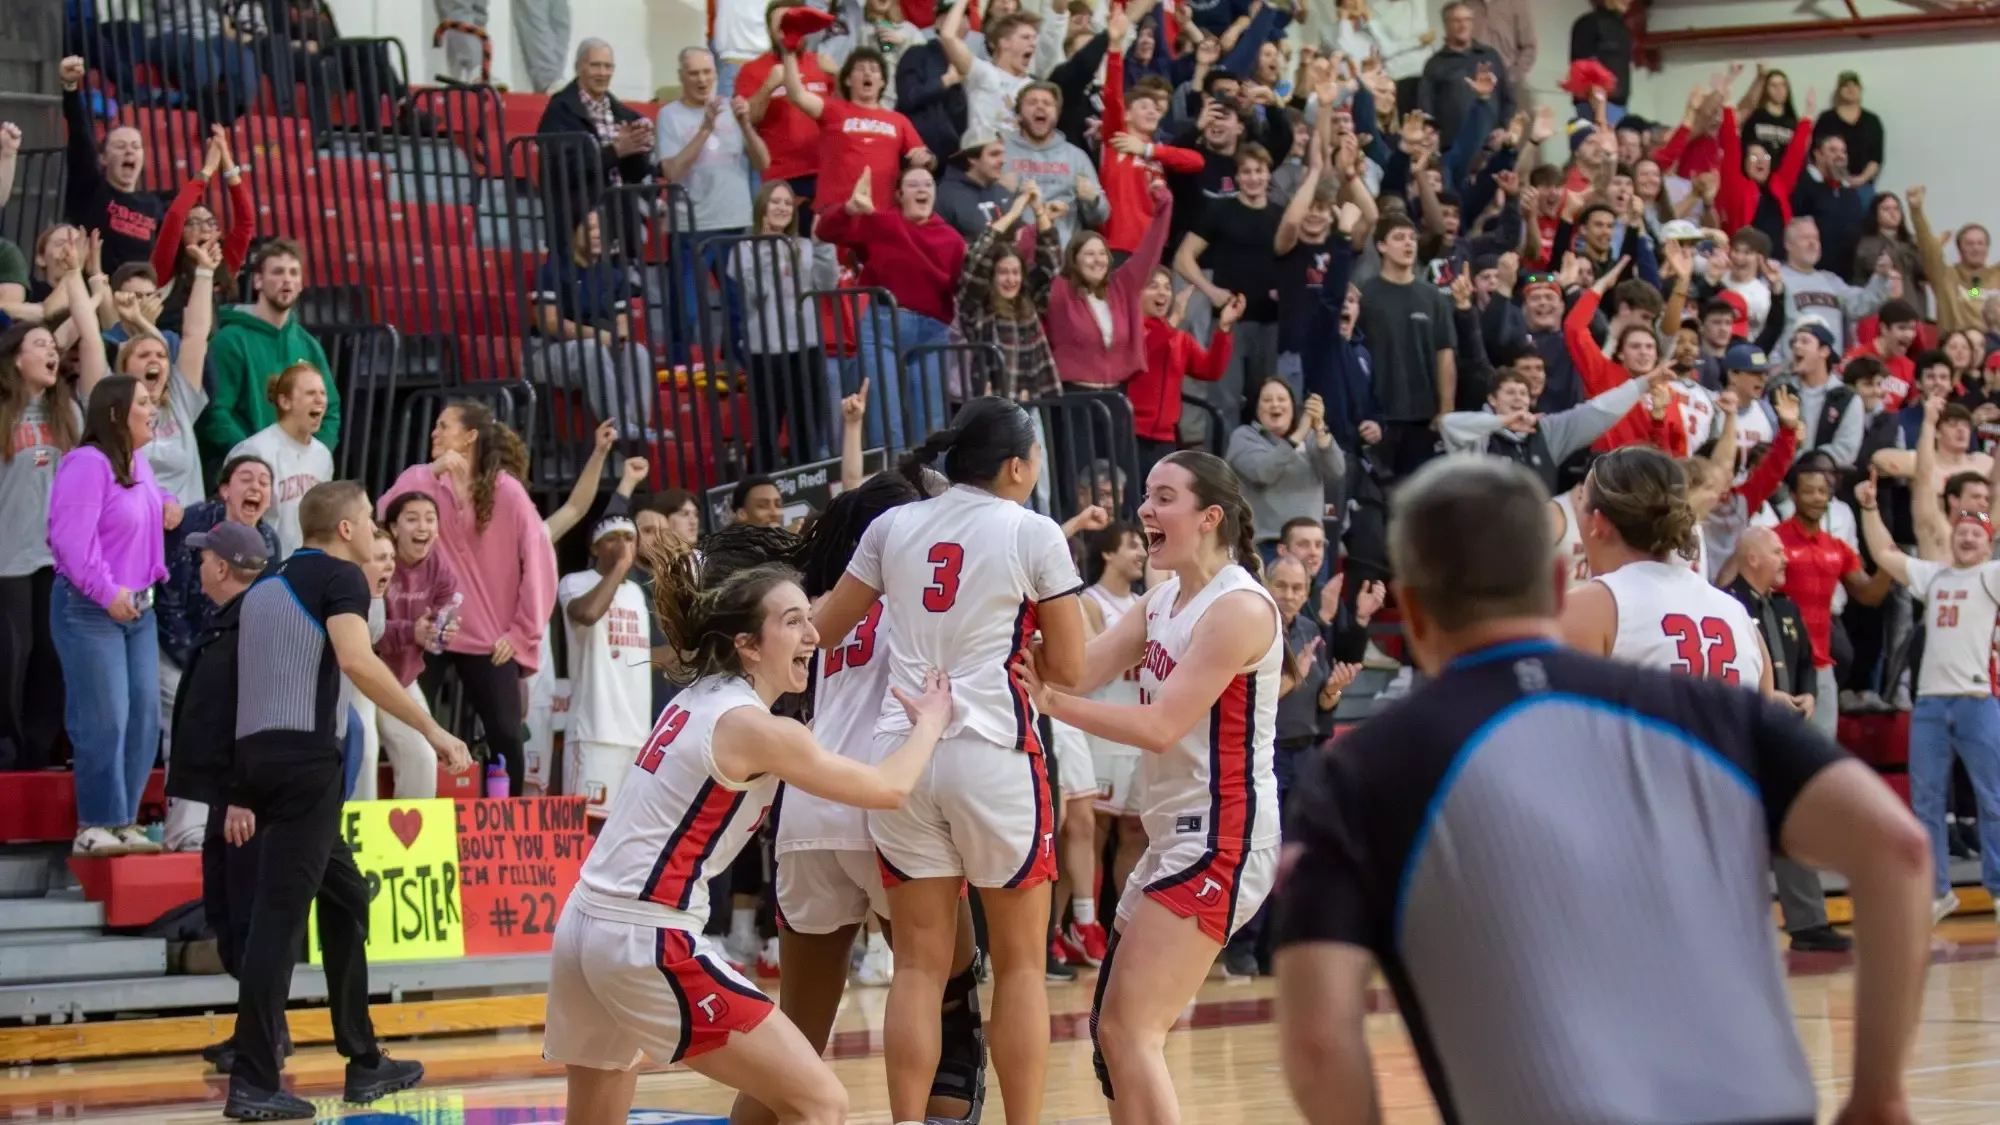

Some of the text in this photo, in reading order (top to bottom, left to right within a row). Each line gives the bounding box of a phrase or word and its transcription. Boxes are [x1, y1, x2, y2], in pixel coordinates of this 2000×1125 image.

[798, 468, 828, 489] Red!
[922, 541, 964, 613] 3
[1936, 604, 1959, 628] 20
[1661, 613, 1740, 687] 32
[635, 704, 690, 775] 12
[346, 811, 362, 853] E
[455, 798, 587, 833] I DON'T KNOW
[553, 833, 585, 860] BUT
[489, 892, 558, 937] #22
